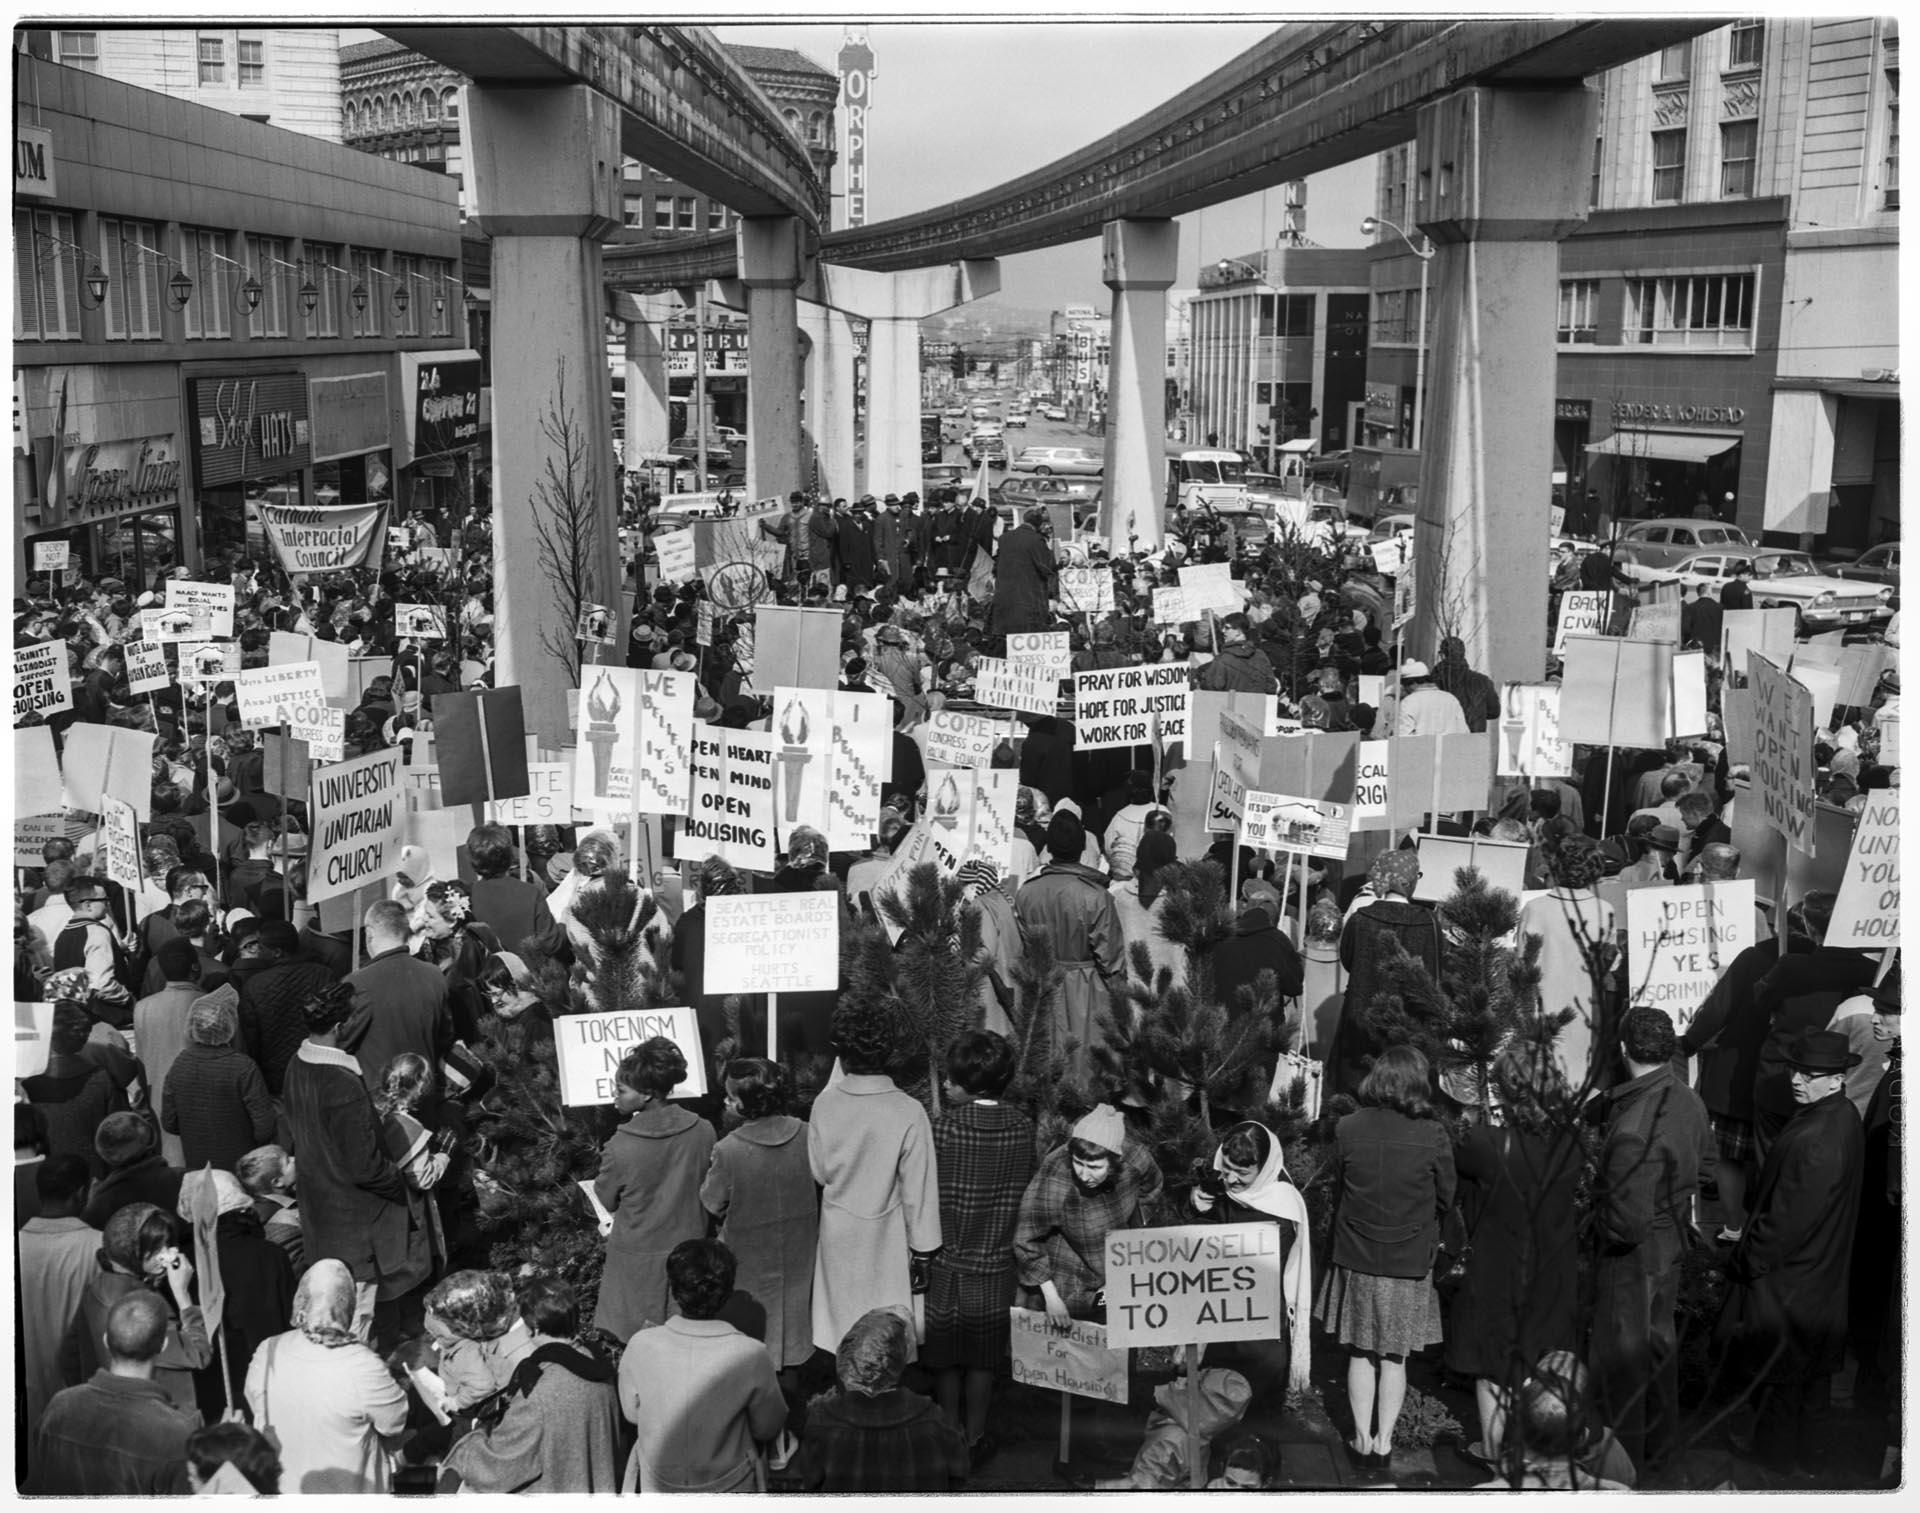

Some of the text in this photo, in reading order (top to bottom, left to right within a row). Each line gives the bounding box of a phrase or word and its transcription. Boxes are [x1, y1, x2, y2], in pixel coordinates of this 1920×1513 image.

[1079, 336, 1089, 380] BUS
[1677, 406, 1745, 424] KOHLSTAD
[261, 411, 294, 458] HATS
[265, 506, 325, 525] Catholic
[280, 525, 360, 547] Interracial
[295, 547, 347, 568] Council
[201, 591, 227, 599] WANTS
[1012, 633, 1066, 651] CORE
[264, 668, 317, 684] LIBERTY
[644, 671, 676, 697] WE
[1078, 666, 1190, 692] PRAY FOR WISDOM
[13, 677, 54, 699] OPEN
[264, 689, 321, 705] JUSTICE
[1755, 671, 1792, 725] WE
[295, 705, 342, 728] CORE
[854, 704, 859, 723] I
[1079, 700, 1109, 719] HOPE
[1113, 698, 1137, 717] FOR
[246, 715, 271, 726] FOR
[641, 694, 689, 769] BELIEVE
[935, 711, 991, 737] CORE
[1080, 718, 1185, 744] WORK FOR EACE
[1754, 699, 1800, 747] WANT
[690, 739, 772, 764] PEN HEART
[929, 731, 967, 750] CONGRESS
[832, 725, 879, 797] BELIEVE
[954, 751, 990, 768] EQUALITY
[1756, 728, 1800, 781] OPEN
[319, 757, 397, 810] UNIVERSITY
[690, 763, 771, 790] PEN MIND
[994, 772, 999, 789] I
[1754, 751, 1812, 819] HOUSING
[640, 767, 689, 812] RIGHT
[1249, 792, 1278, 804] SEATTLE
[493, 796, 554, 819] YES
[701, 793, 751, 818] OPEN
[829, 790, 876, 830] RIGHT
[976, 786, 1010, 843] BELIEVE
[1260, 803, 1272, 813] UP
[1764, 789, 1806, 838] NOW
[22, 824, 56, 833] CAN BE
[323, 806, 393, 850] UNITARIAN
[685, 817, 767, 848] HOUSING
[1246, 822, 1267, 837] YOU
[327, 847, 383, 886] CHURCH
[715, 897, 836, 915] SEATTLE REAL
[1665, 899, 1725, 921] OPEN
[712, 914, 768, 928] ESTATE
[711, 927, 832, 945] SEGREGATIONIST
[1642, 924, 1737, 949] HOUSING
[744, 943, 797, 957] POLICY
[1672, 951, 1720, 972] YES
[751, 962, 799, 976] HURTS
[741, 975, 815, 989] SEATTLE
[575, 1014, 677, 1044] TOKENISM
[1110, 1231, 1275, 1267] SHOW/SELL
[1130, 1265, 1256, 1298] HOMES
[1119, 1297, 1270, 1330] TO ALL
[1047, 1342, 1069, 1358] For
[1013, 1359, 1118, 1398] Open Housing
